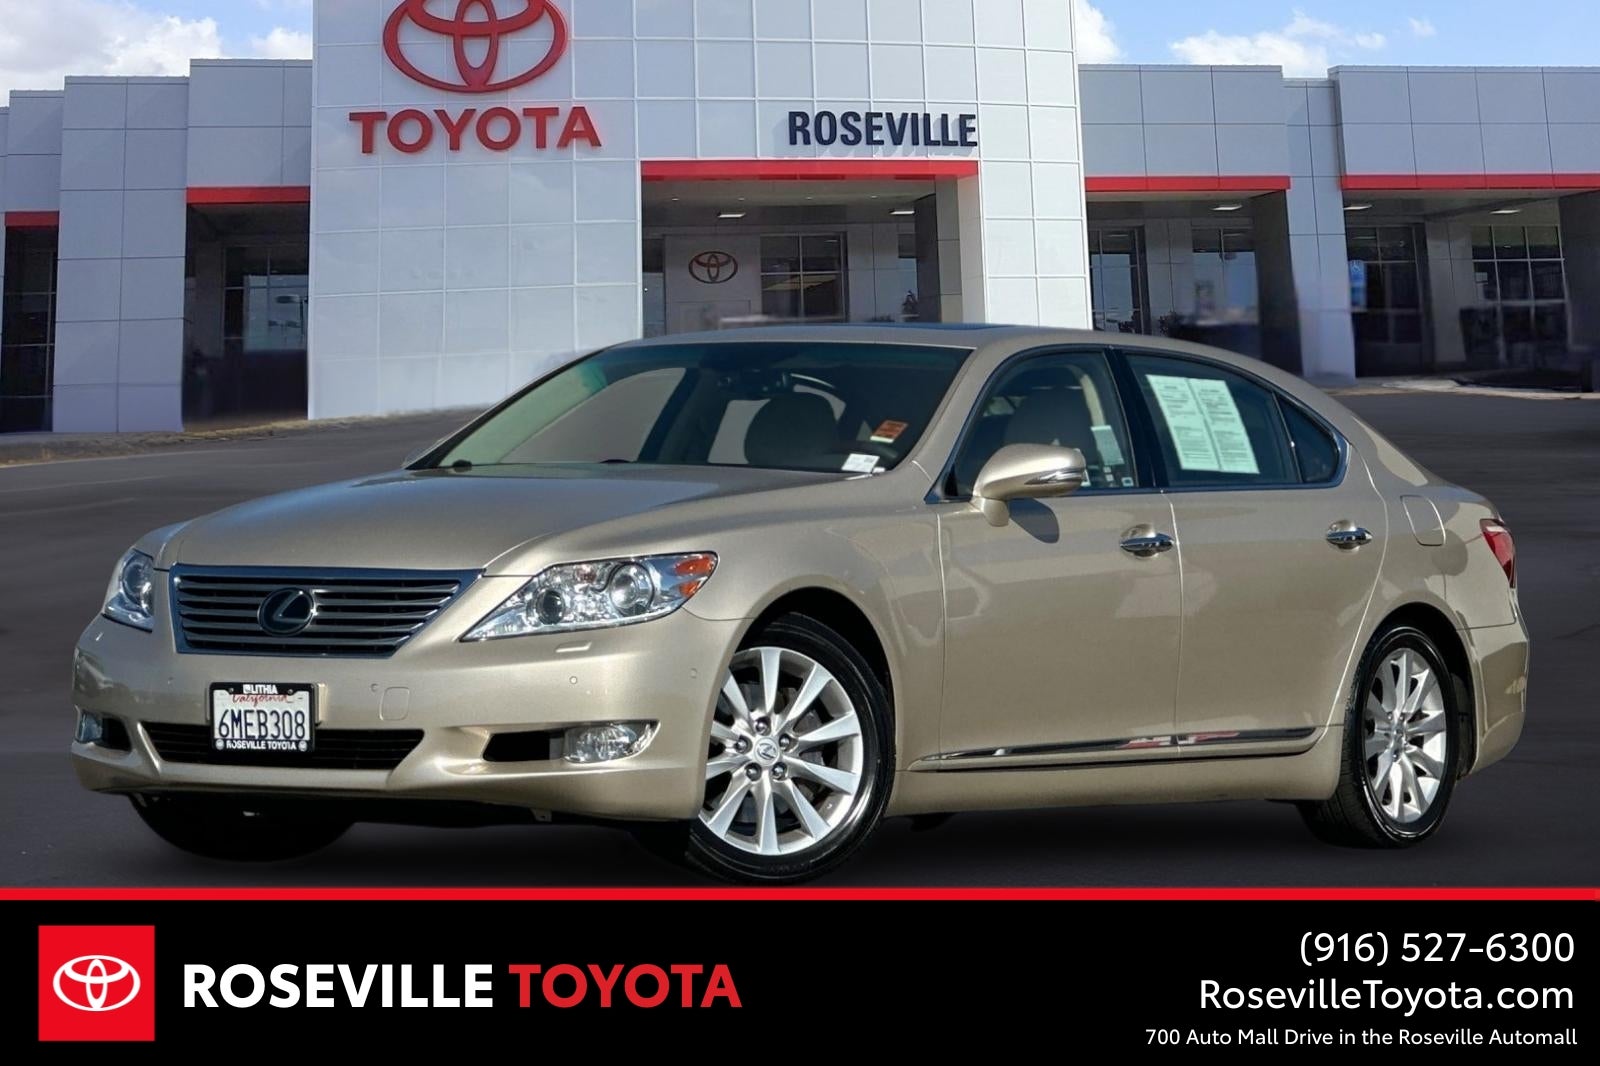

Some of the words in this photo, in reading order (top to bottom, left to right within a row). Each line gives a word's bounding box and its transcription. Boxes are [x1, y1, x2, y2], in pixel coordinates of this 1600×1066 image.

[349, 105, 602, 154] TOYOTA
[788, 111, 978, 147] ROSEVILLE
[251, 684, 278, 694] LITHIA
[219, 709, 305, 739] 6MEB308
[226, 740, 266, 750] ROSEVILLE
[268, 741, 297, 750] TOYOTA
